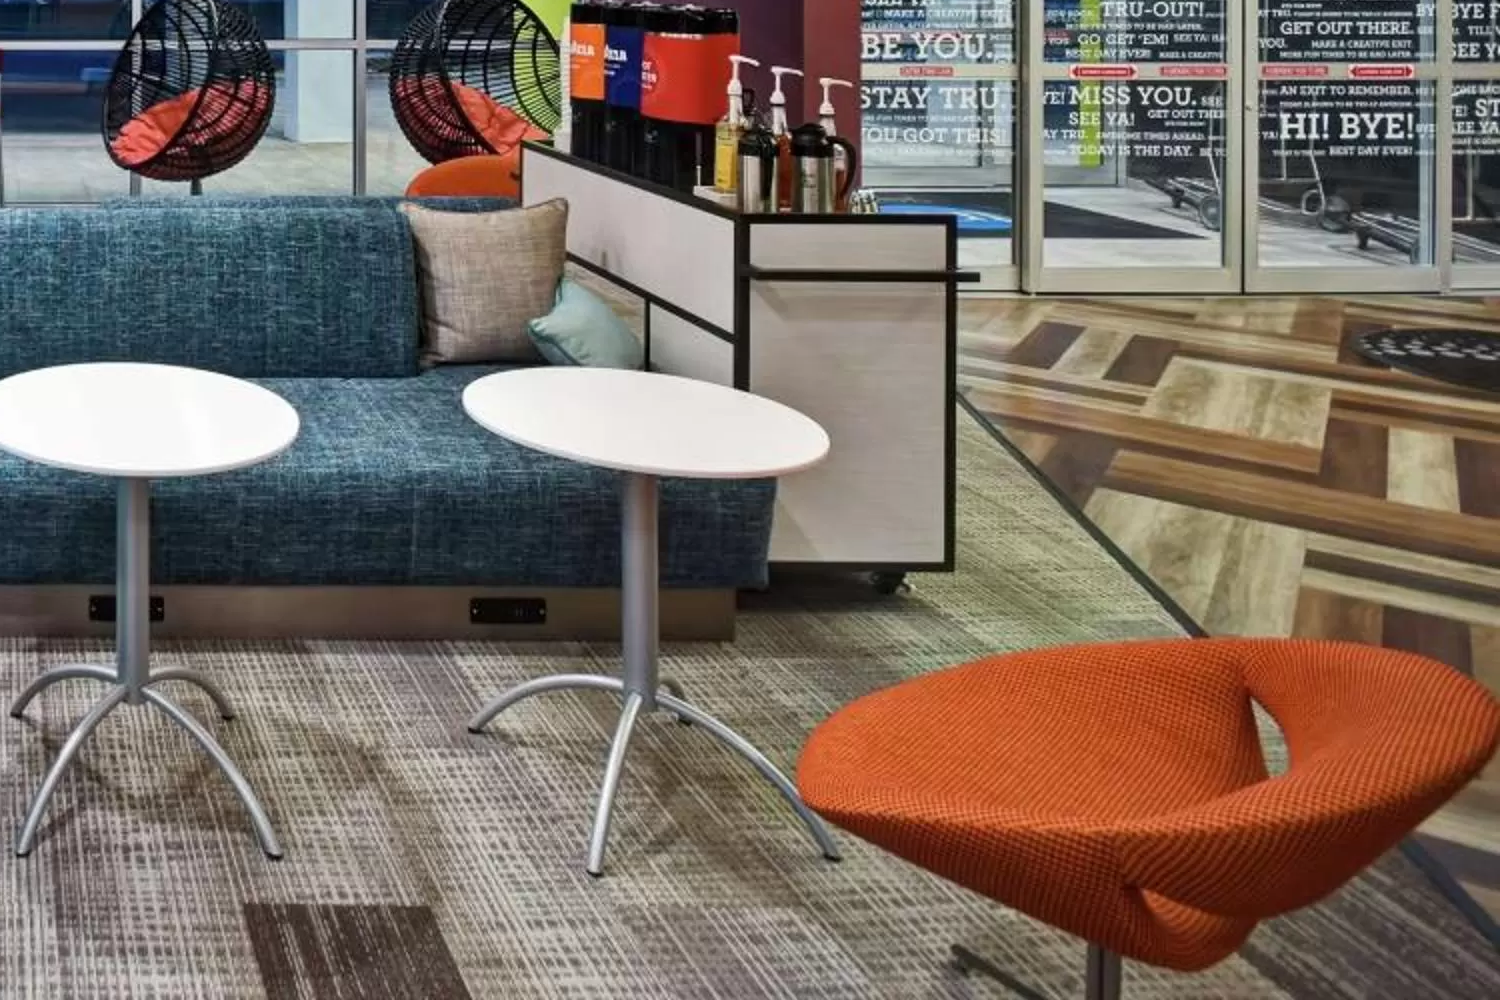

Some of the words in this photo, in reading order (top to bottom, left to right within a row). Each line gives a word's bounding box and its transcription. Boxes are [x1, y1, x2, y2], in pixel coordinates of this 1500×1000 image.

[1100, 1, 1204, 17] TRU-OUT!
[1280, 21, 1314, 35] GET
[1317, 21, 1353, 35] OUT
[1355, 21, 1414, 35] THERE.
[861, 33, 901, 59] BE
[910, 32, 993, 60] YOU.
[1077, 33, 1101, 46] GO
[1105, 33, 1135, 46] GET
[861, 87, 931, 109] STAY
[938, 87, 1007, 109] TRU.
[1069, 86, 1131, 105] MISS
[1136, 86, 1197, 106] YOU.
[1280, 85, 1298, 96] AN
[1329, 85, 1347, 96] TO
[1069, 111, 1100, 127] SEE
[1105, 111, 1135, 127] YA!
[1171, 109, 1195, 119] OUT
[1279, 113, 1329, 139] HI!
[1339, 113, 1414, 139] BYE!
[903, 127, 948, 143] GOT
[1133, 145, 1161, 156] THE
[1163, 145, 1193, 157] DAY.
